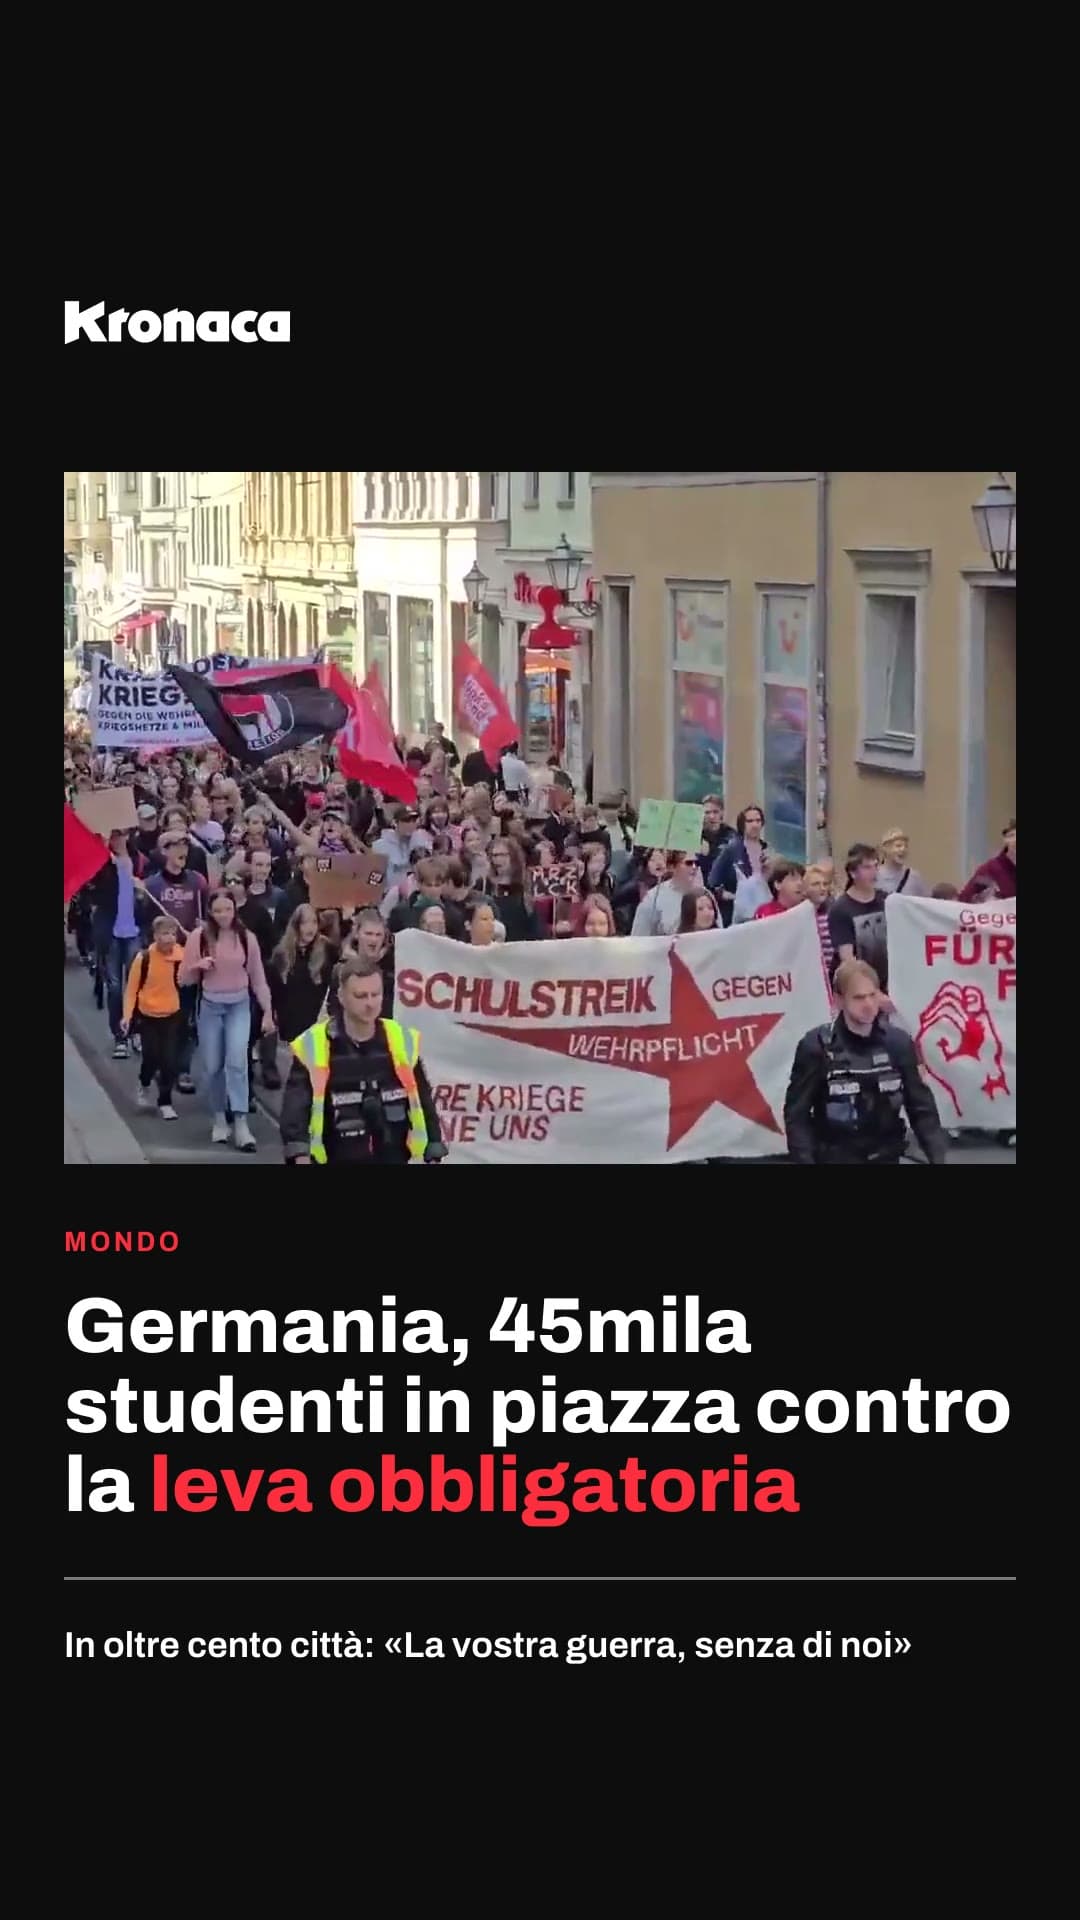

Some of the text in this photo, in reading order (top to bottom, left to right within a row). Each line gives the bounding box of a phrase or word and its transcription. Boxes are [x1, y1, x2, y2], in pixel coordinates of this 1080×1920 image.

[99, 684, 191, 707] KRIEG
[183, 721, 206, 731] MIL
[925, 926, 1015, 967] FÜR
[397, 969, 657, 1018] SCHULSTREIK
[712, 972, 792, 1002] GEGEN
[568, 1024, 758, 1062] WEHRPFLICHT
[476, 1084, 586, 1113] KRIEGE
[489, 1114, 550, 1141] UNS
